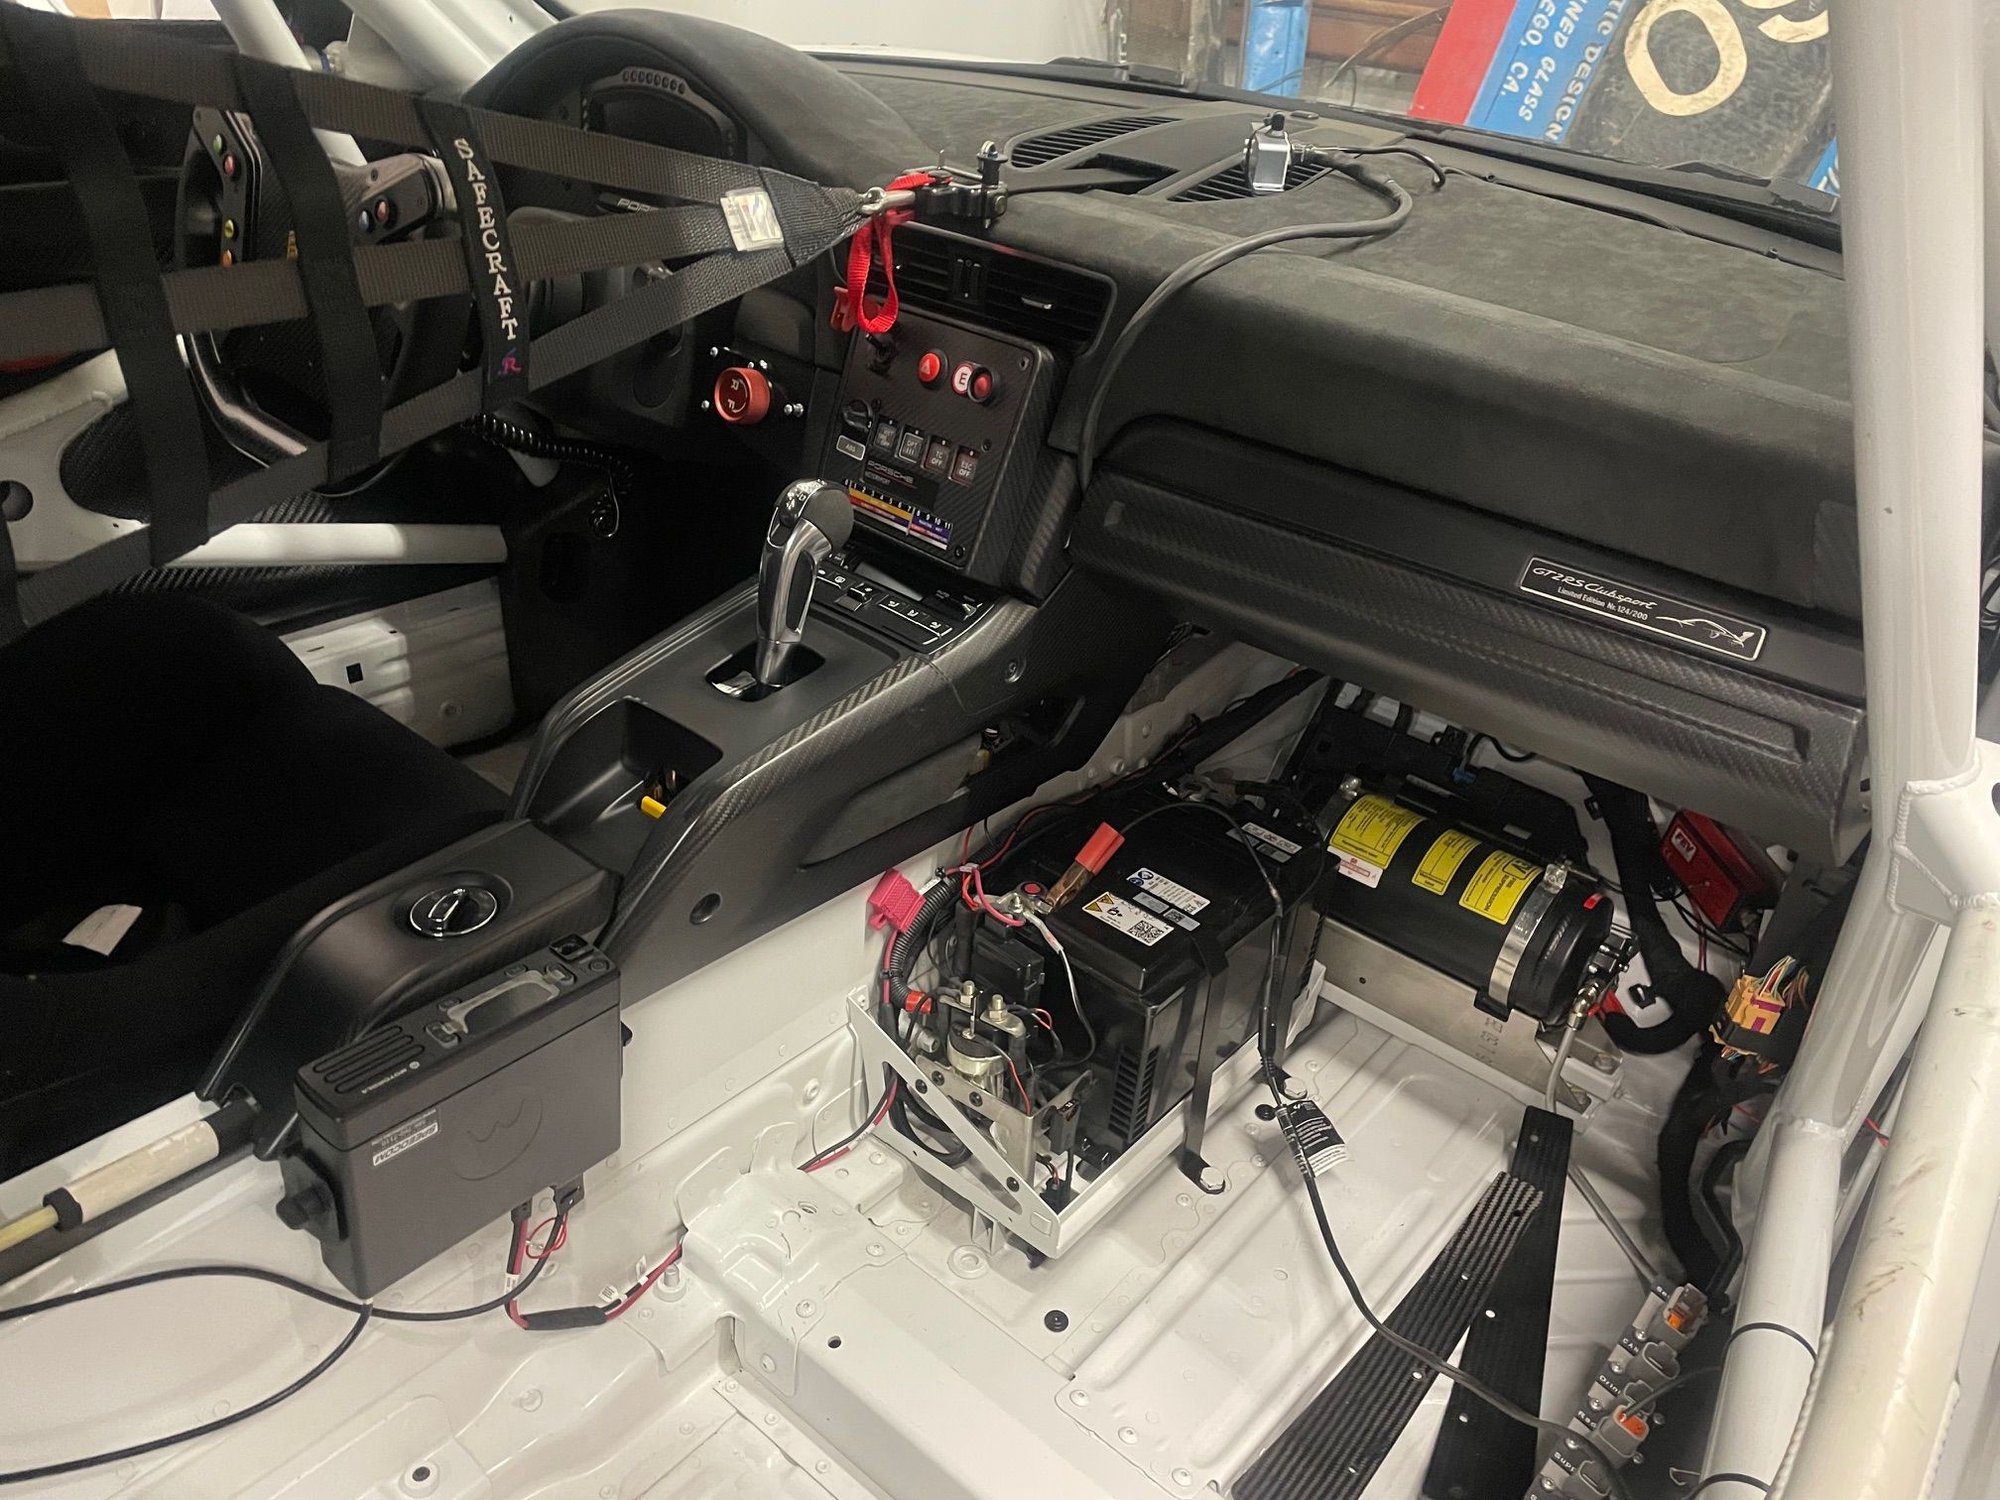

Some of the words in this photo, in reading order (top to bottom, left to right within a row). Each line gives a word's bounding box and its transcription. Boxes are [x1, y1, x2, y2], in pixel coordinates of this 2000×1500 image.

[1500, 61, 1528, 96] CA.
[1518, 55, 1556, 122] GLASS
[1544, 43, 1602, 141] DESIGN
[454, 138, 518, 341] SAFECRAFT
[959, 372, 968, 386] E
[1557, 586, 1582, 600] Limited
[1582, 593, 1606, 607] Edition
[1584, 583, 1657, 610] Clubsport
